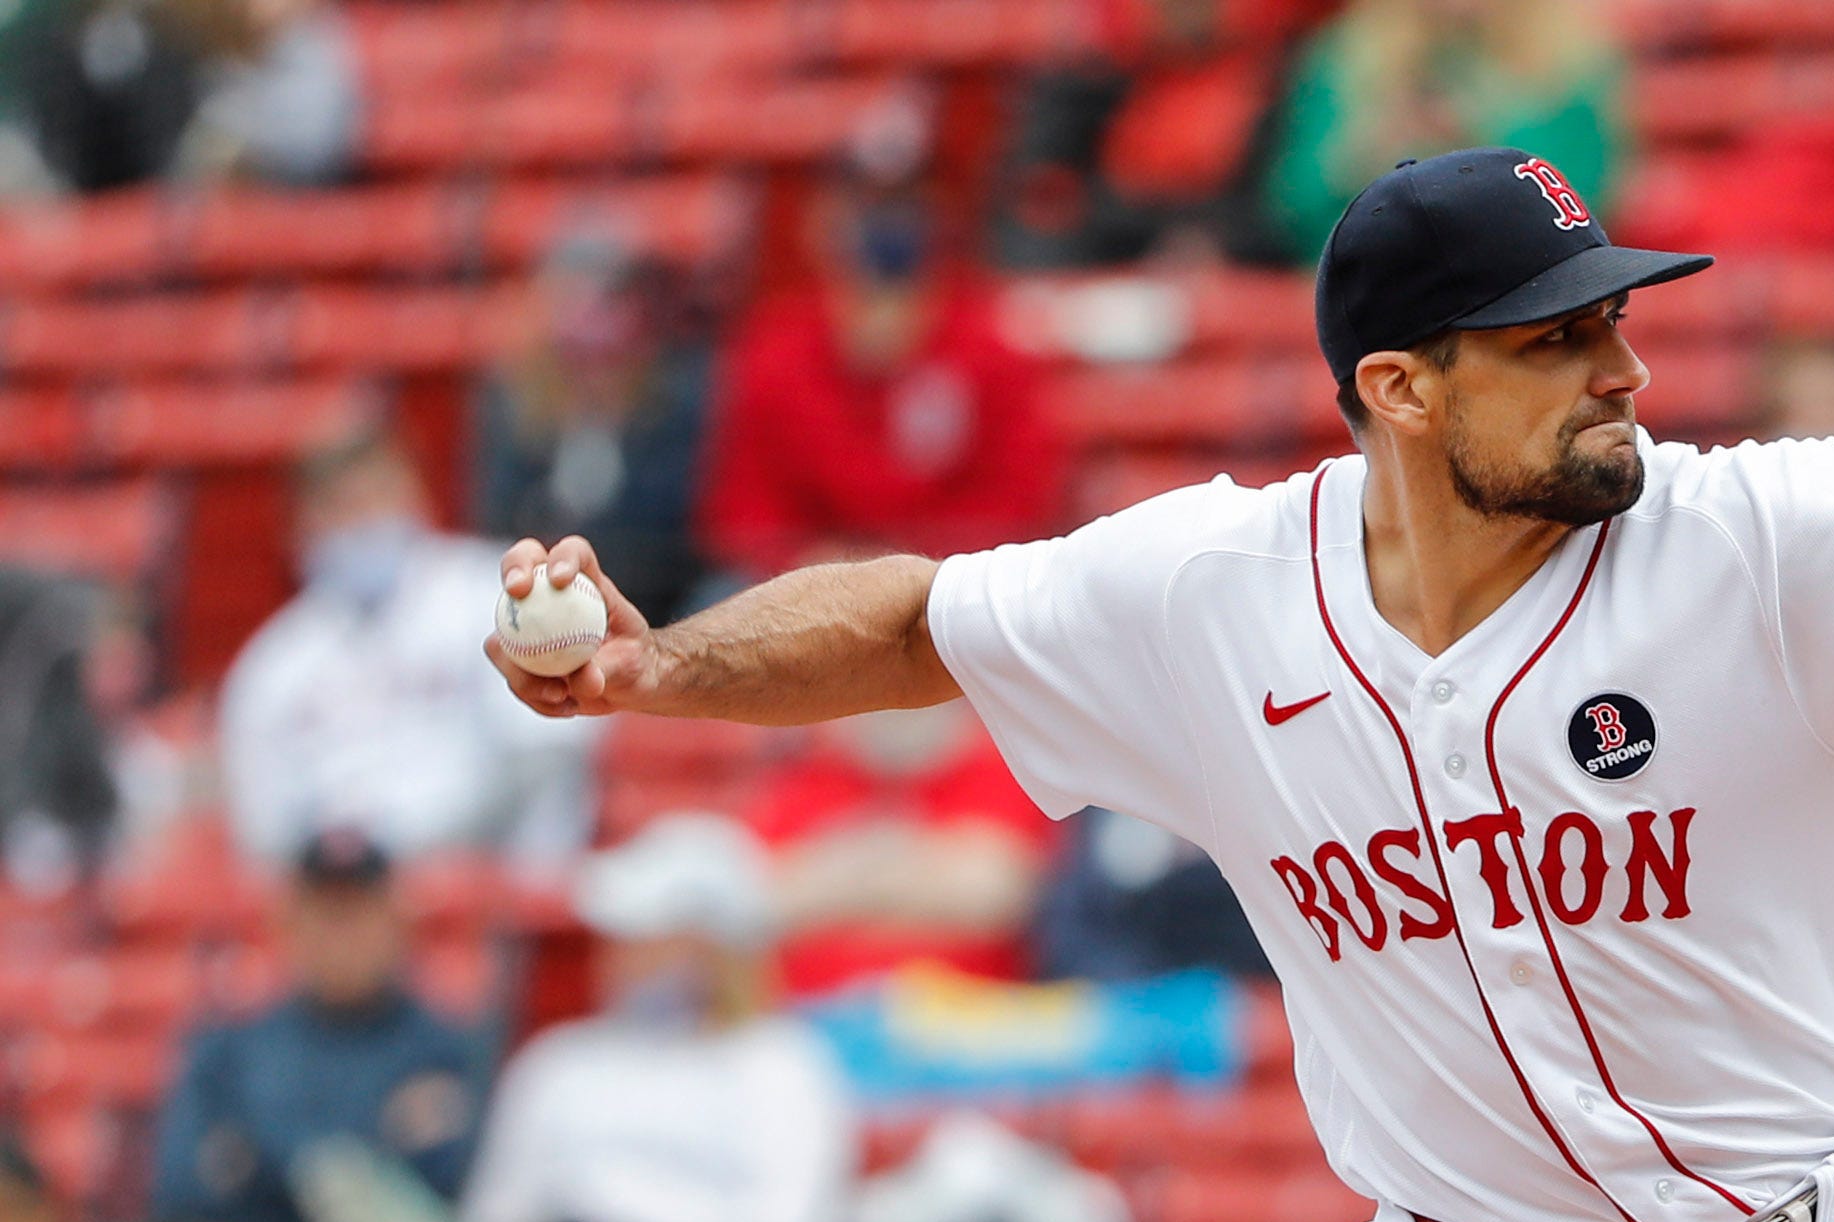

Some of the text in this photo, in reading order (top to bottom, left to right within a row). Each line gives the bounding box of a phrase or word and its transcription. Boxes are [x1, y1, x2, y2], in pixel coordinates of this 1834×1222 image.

[1514, 158, 1590, 230] B
[1585, 702, 1627, 752] B
[1586, 739, 1653, 773] STRONG
[1270, 806, 1697, 963] BOSTON
